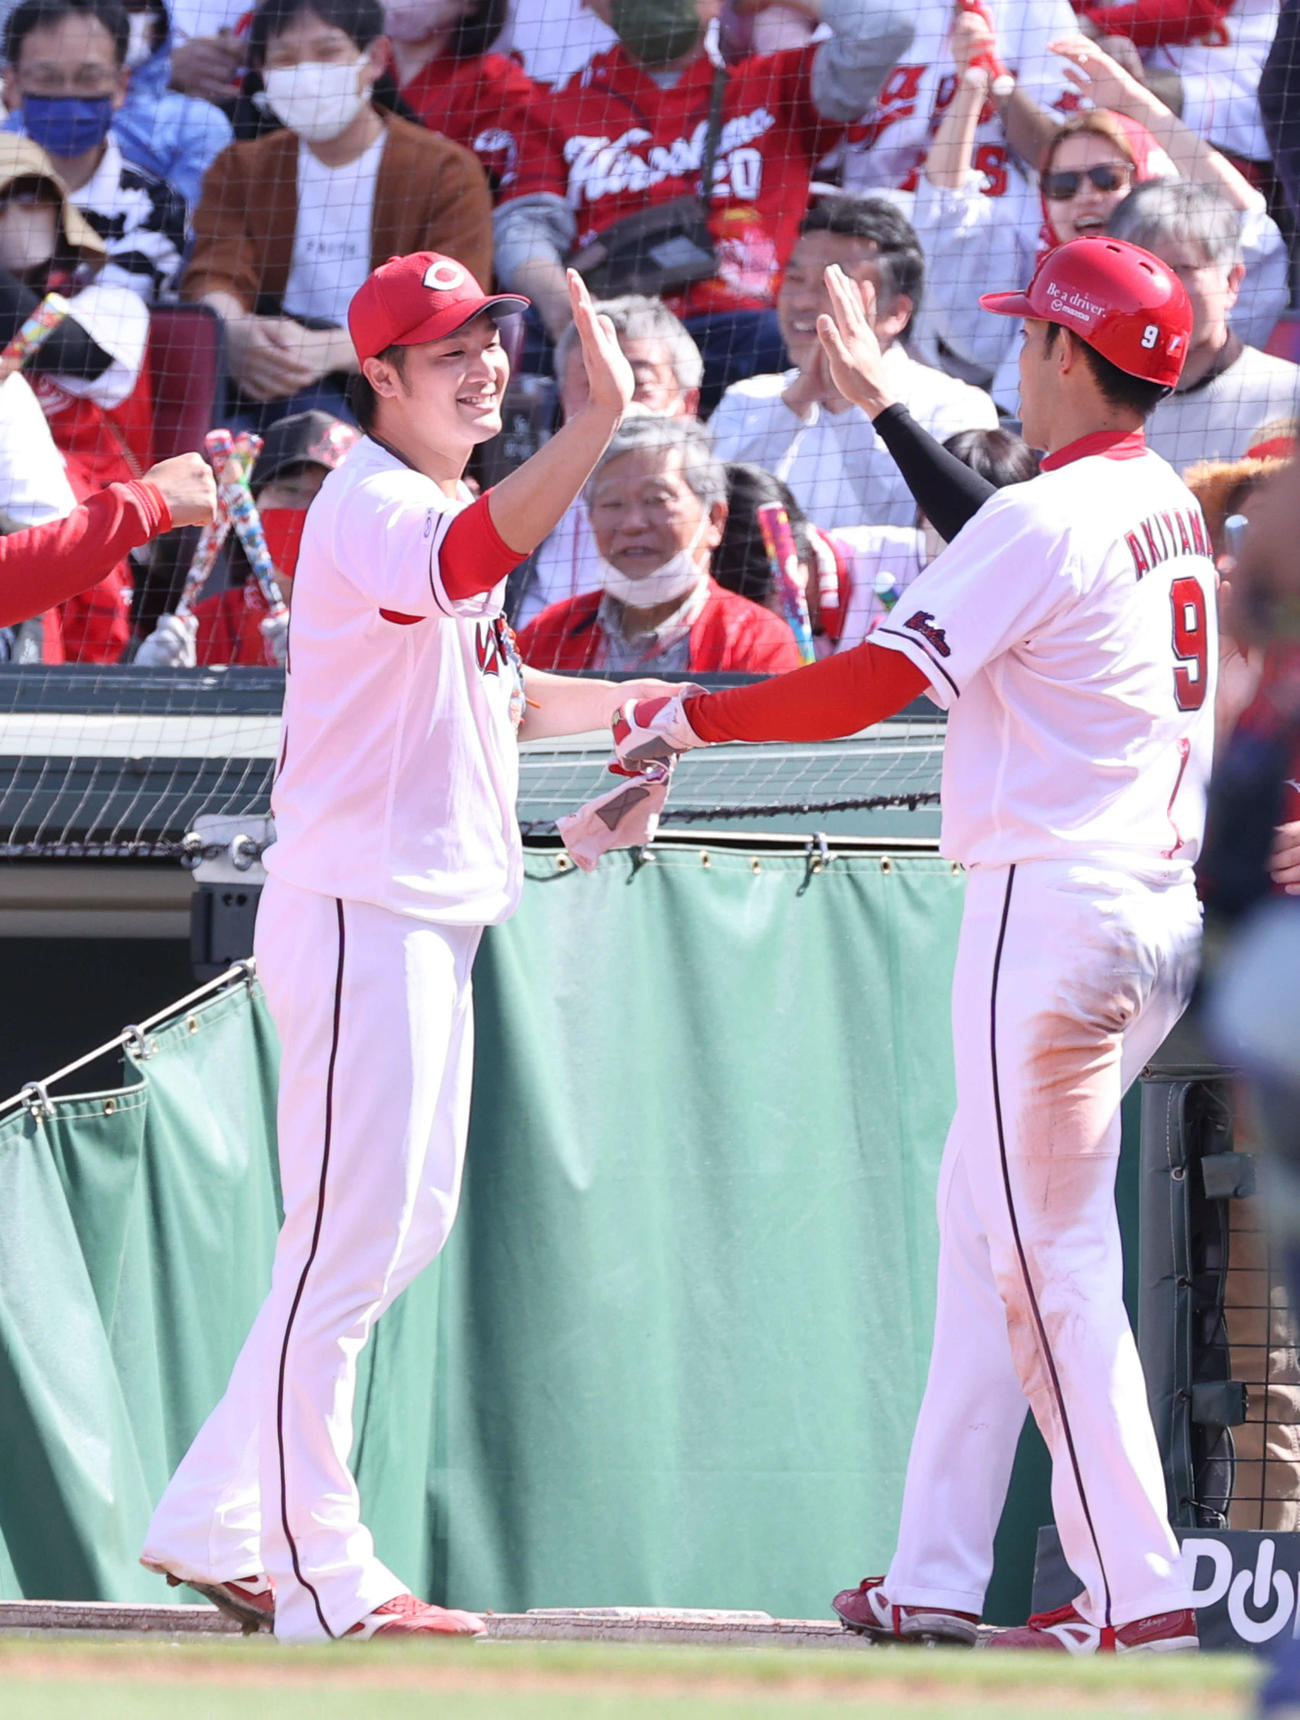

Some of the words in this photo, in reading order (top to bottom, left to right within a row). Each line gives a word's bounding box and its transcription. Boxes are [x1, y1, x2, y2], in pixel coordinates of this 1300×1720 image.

[1046, 282, 1061, 298] Be
[1060, 292, 1068, 301] a
[1069, 291, 1107, 318] driver.
[1140, 324, 1160, 349] 9
[1169, 576, 1208, 712] 9
